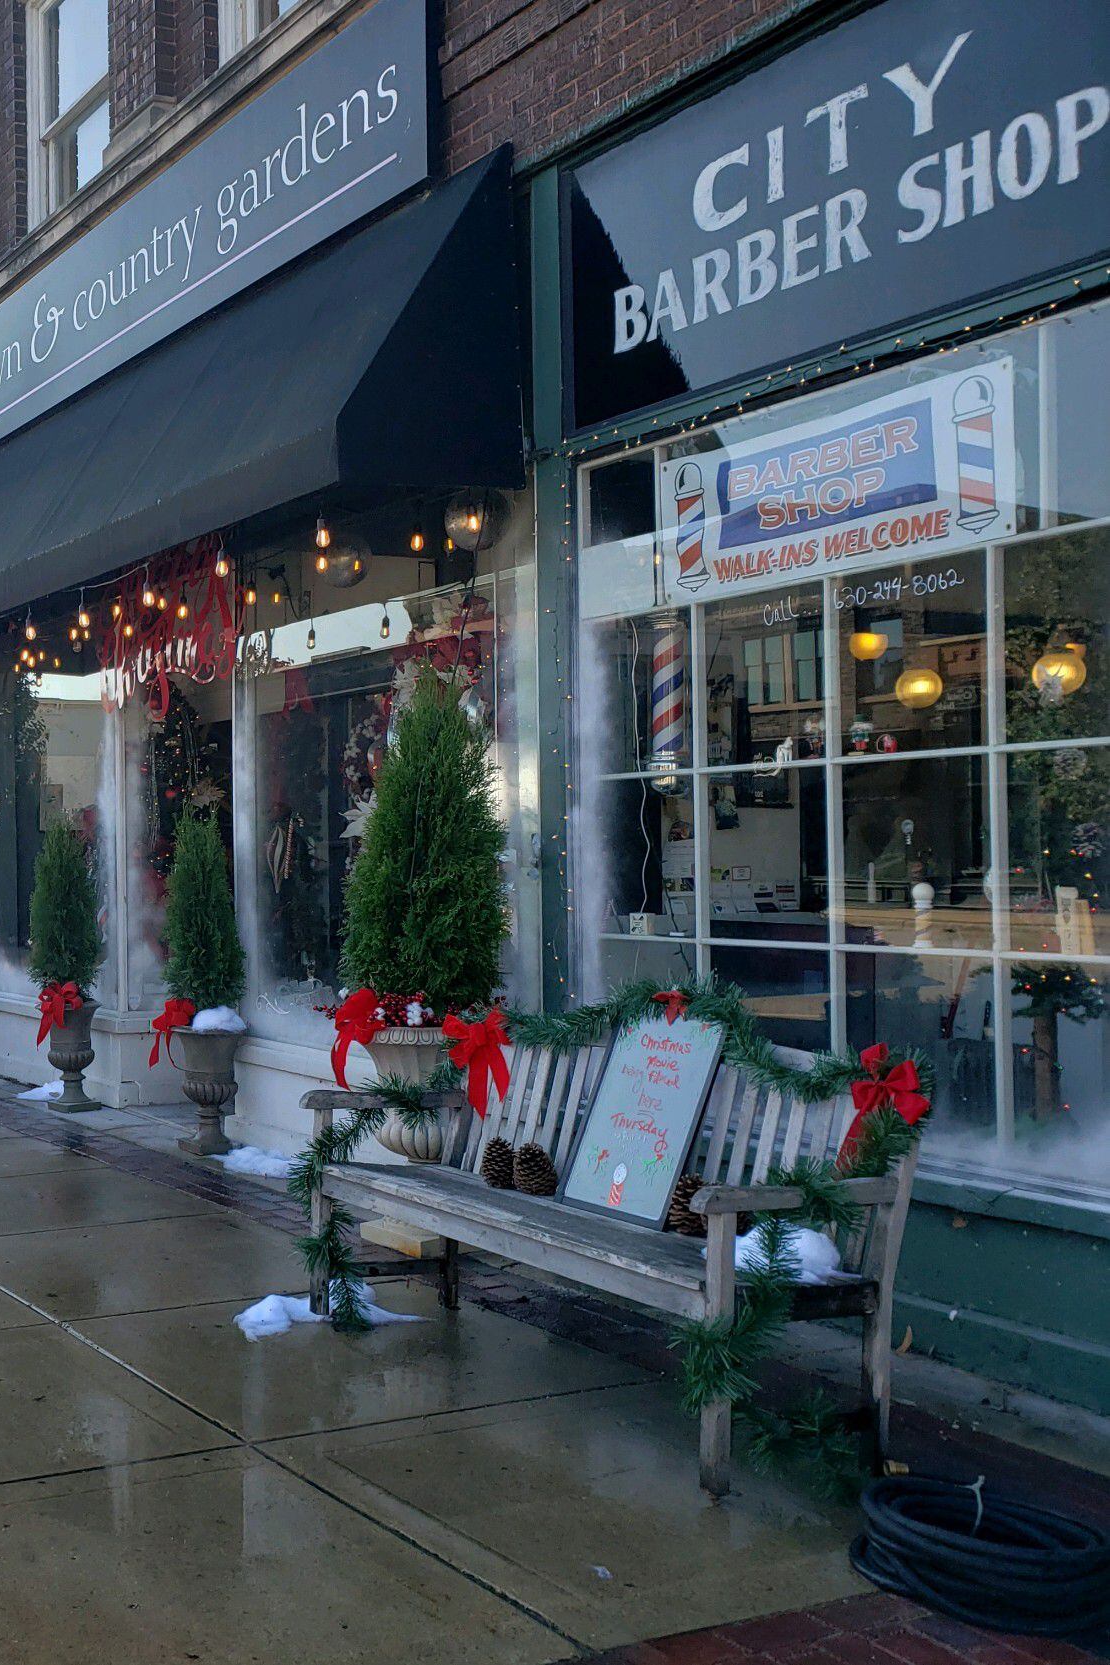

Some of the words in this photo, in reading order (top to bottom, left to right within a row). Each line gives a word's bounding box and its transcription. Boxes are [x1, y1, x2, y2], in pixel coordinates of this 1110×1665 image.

[692, 30, 973, 233] CITY
[29, 293, 65, 364] &
[71, 204, 202, 332] country
[215, 64, 399, 255] gardens
[613, 187, 872, 356] BARBER
[896, 86, 1110, 245] SHOP
[727, 415, 920, 501] BARBER
[756, 466, 887, 531] SHOP
[713, 538, 820, 584] WALK-INS
[823, 508, 952, 562] WELCOME
[833, 568, 965, 611] 630-244-8062
[640, 1033, 693, 1055] Christmas
[610, 1112, 668, 1152] Thursday
